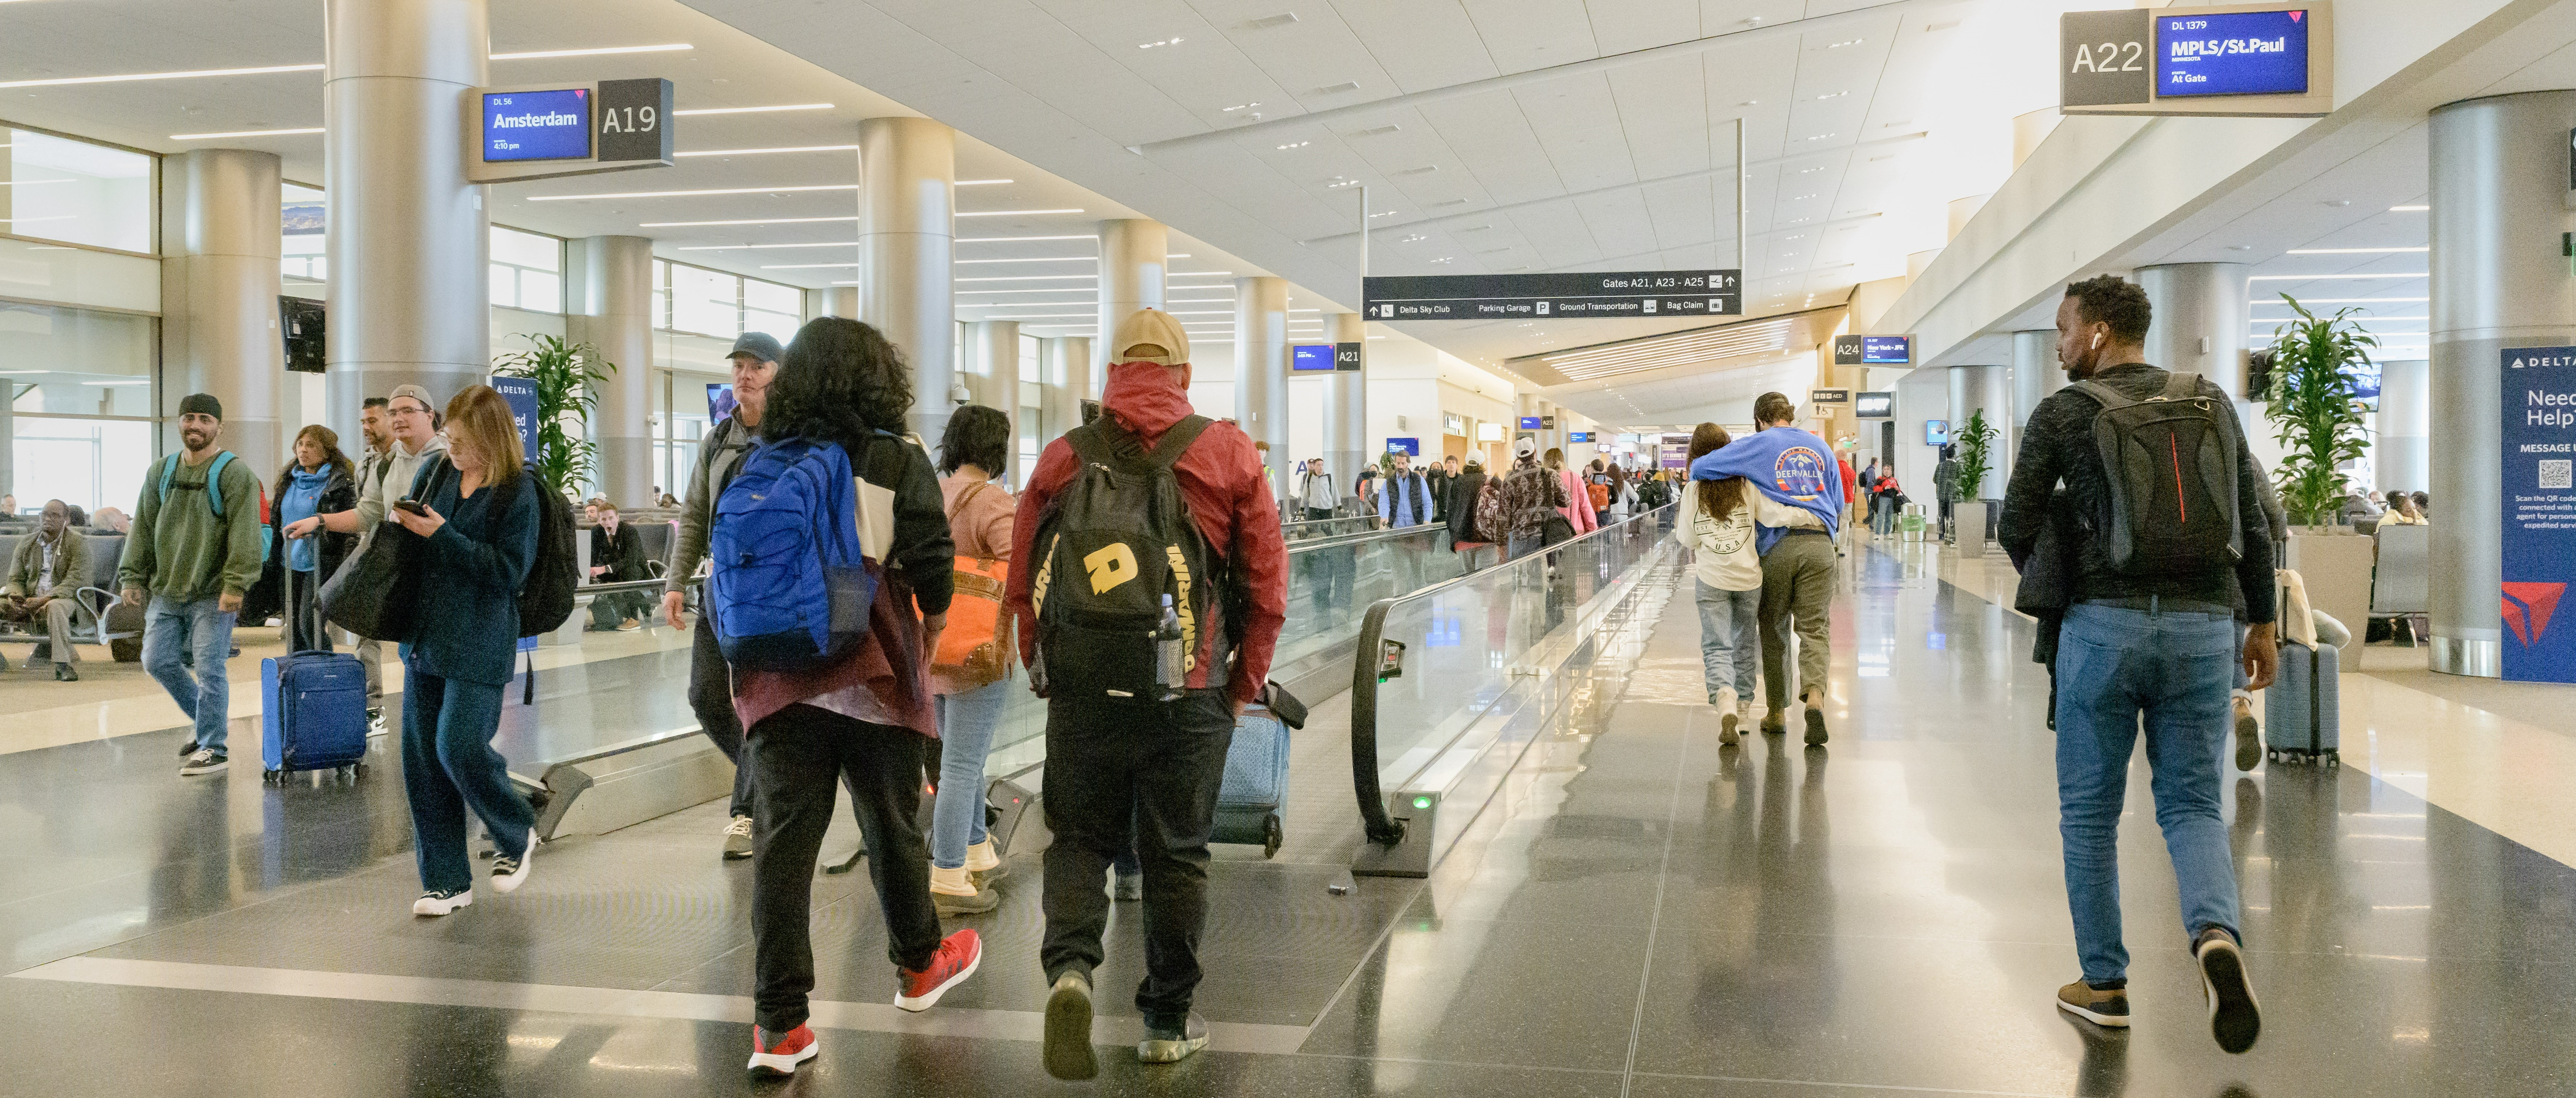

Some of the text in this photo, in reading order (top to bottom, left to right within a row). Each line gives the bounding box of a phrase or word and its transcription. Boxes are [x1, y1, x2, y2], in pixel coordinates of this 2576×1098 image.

[2172, 21, 2207, 30] DL 1379
[2171, 37, 2284, 57] MPLS/St.Paul
[2072, 41, 2143, 73] A22
[2172, 74, 2207, 83] At Gate
[493, 111, 577, 128] Amsterdam
[603, 106, 656, 134] A19
[1603, 279, 1628, 288] Gates
[1631, 278, 1652, 288] A21,
[1656, 278, 1675, 287] A23
[1684, 277, 1703, 286] A25
[1420, 306, 1432, 314] Sky
[1479, 304, 1531, 313] Parking Garage
[1540, 304, 1546, 312] P
[1587, 303, 1638, 311] Transportation
[1667, 302, 1681, 310] Bag
[1837, 345, 1859, 355] A24
[1339, 352, 1359, 361] A21
[504, 386, 526, 394] DELTA
[2520, 444, 2571, 452] MESSAGE
[1776, 470, 1797, 478] DEER
